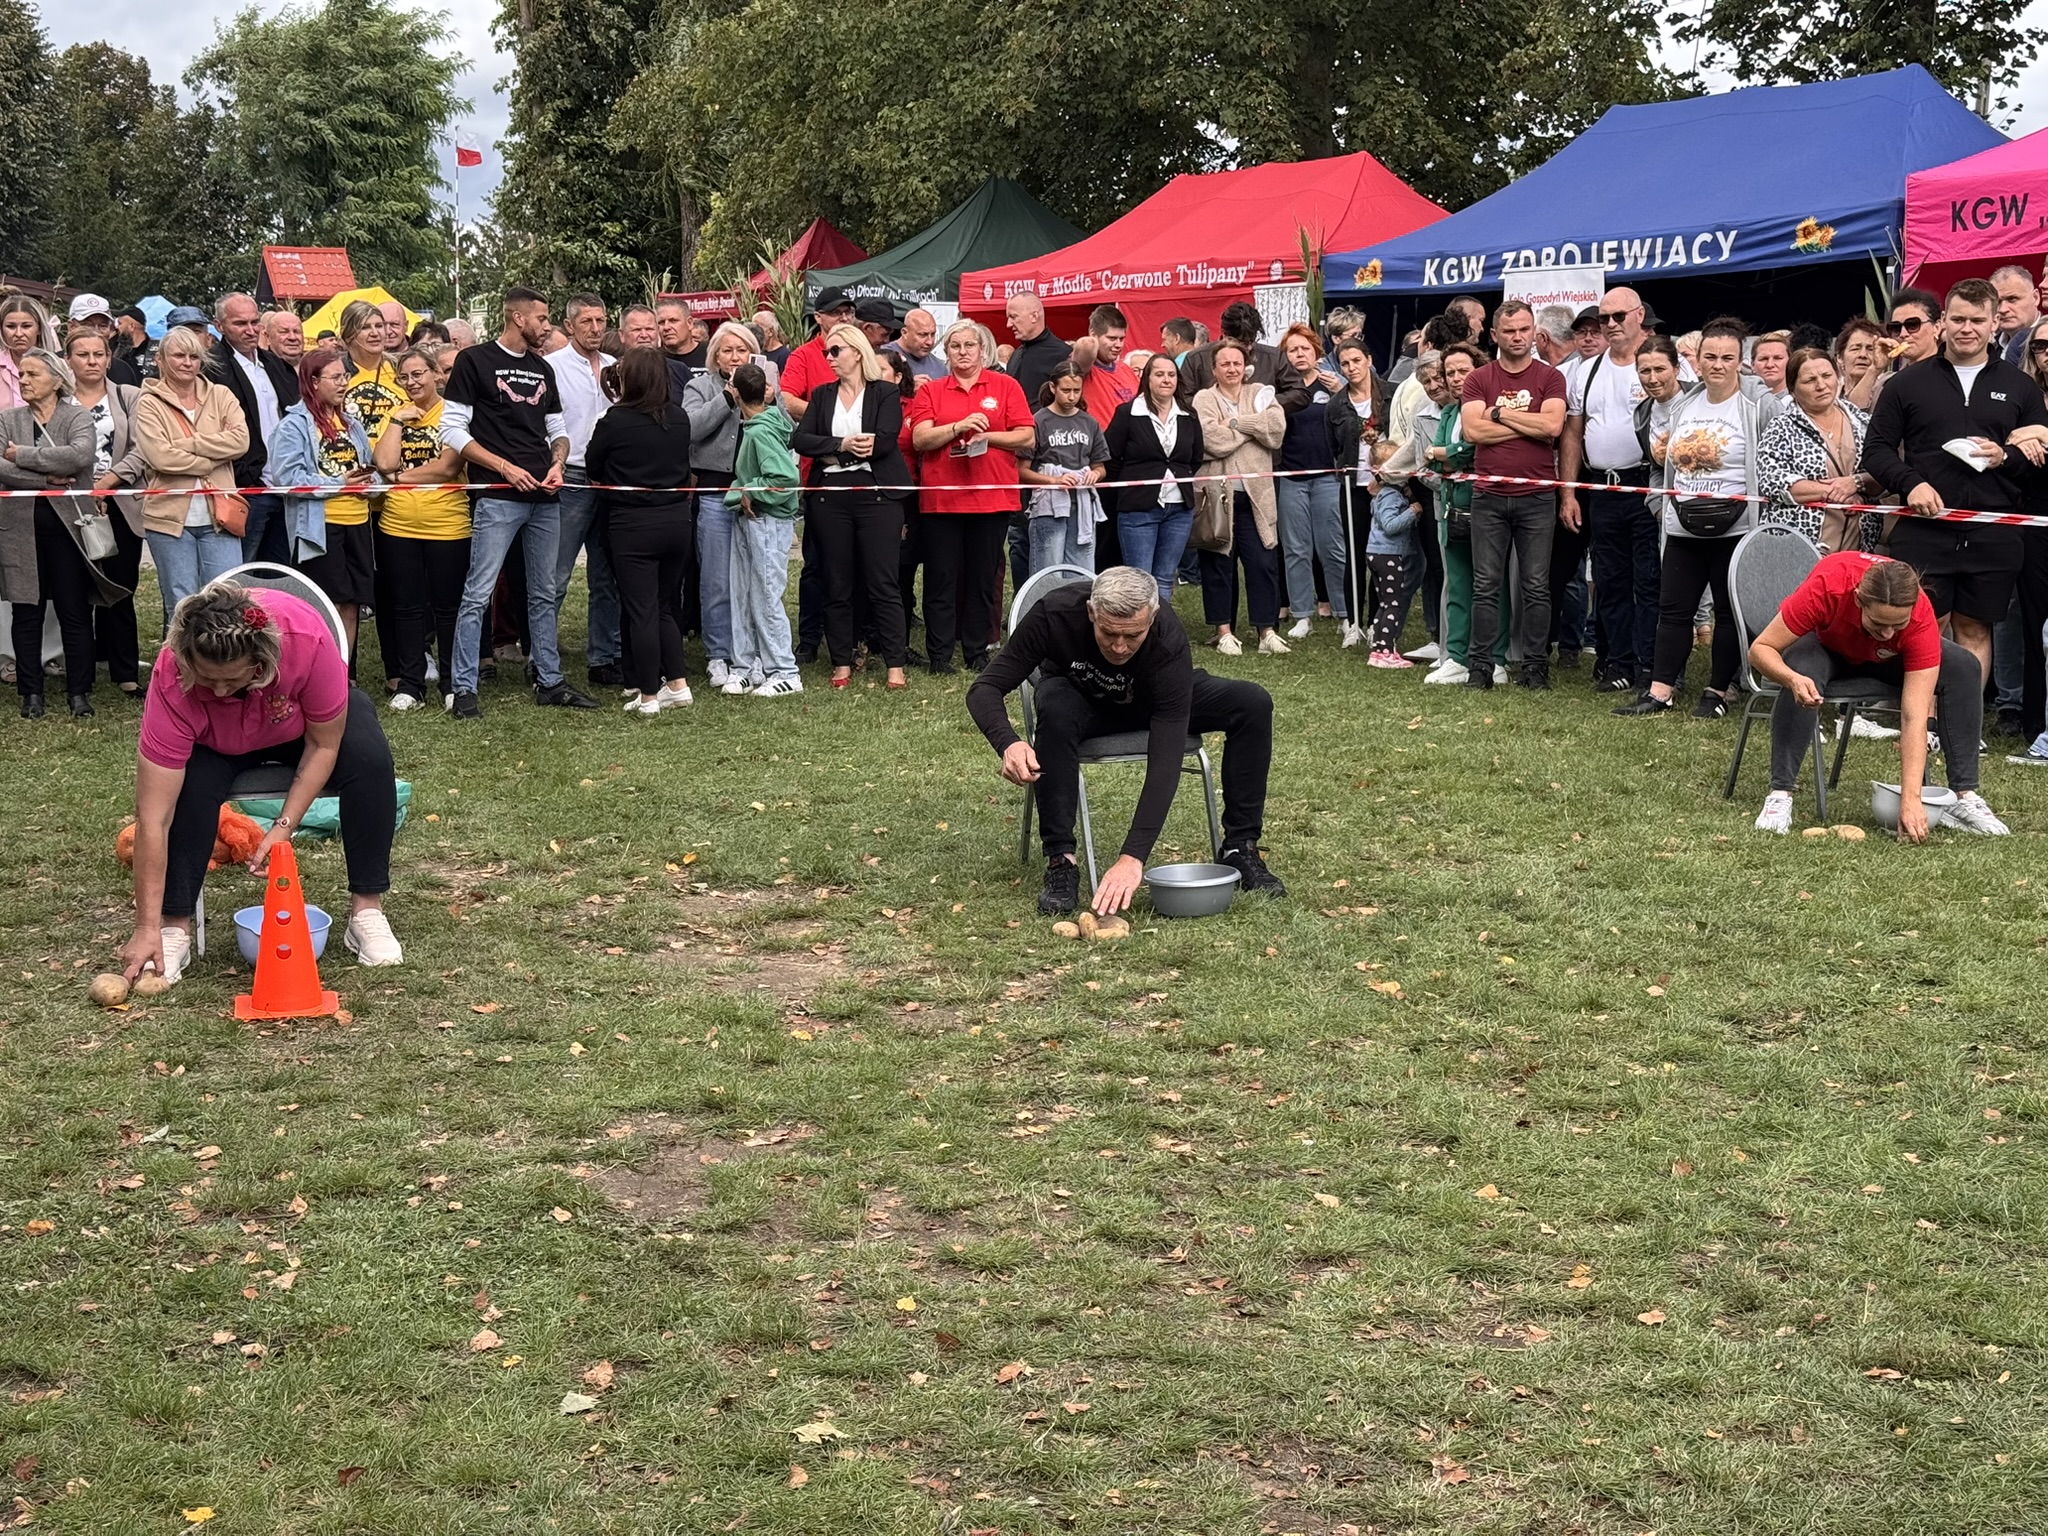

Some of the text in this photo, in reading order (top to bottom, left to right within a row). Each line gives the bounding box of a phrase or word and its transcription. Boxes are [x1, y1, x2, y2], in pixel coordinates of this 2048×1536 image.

[1950, 192, 2030, 233] KGW
[1038, 283, 1049, 297] w
[1177, 260, 1255, 289] Tulipany"
[1422, 254, 1486, 287] KGW
